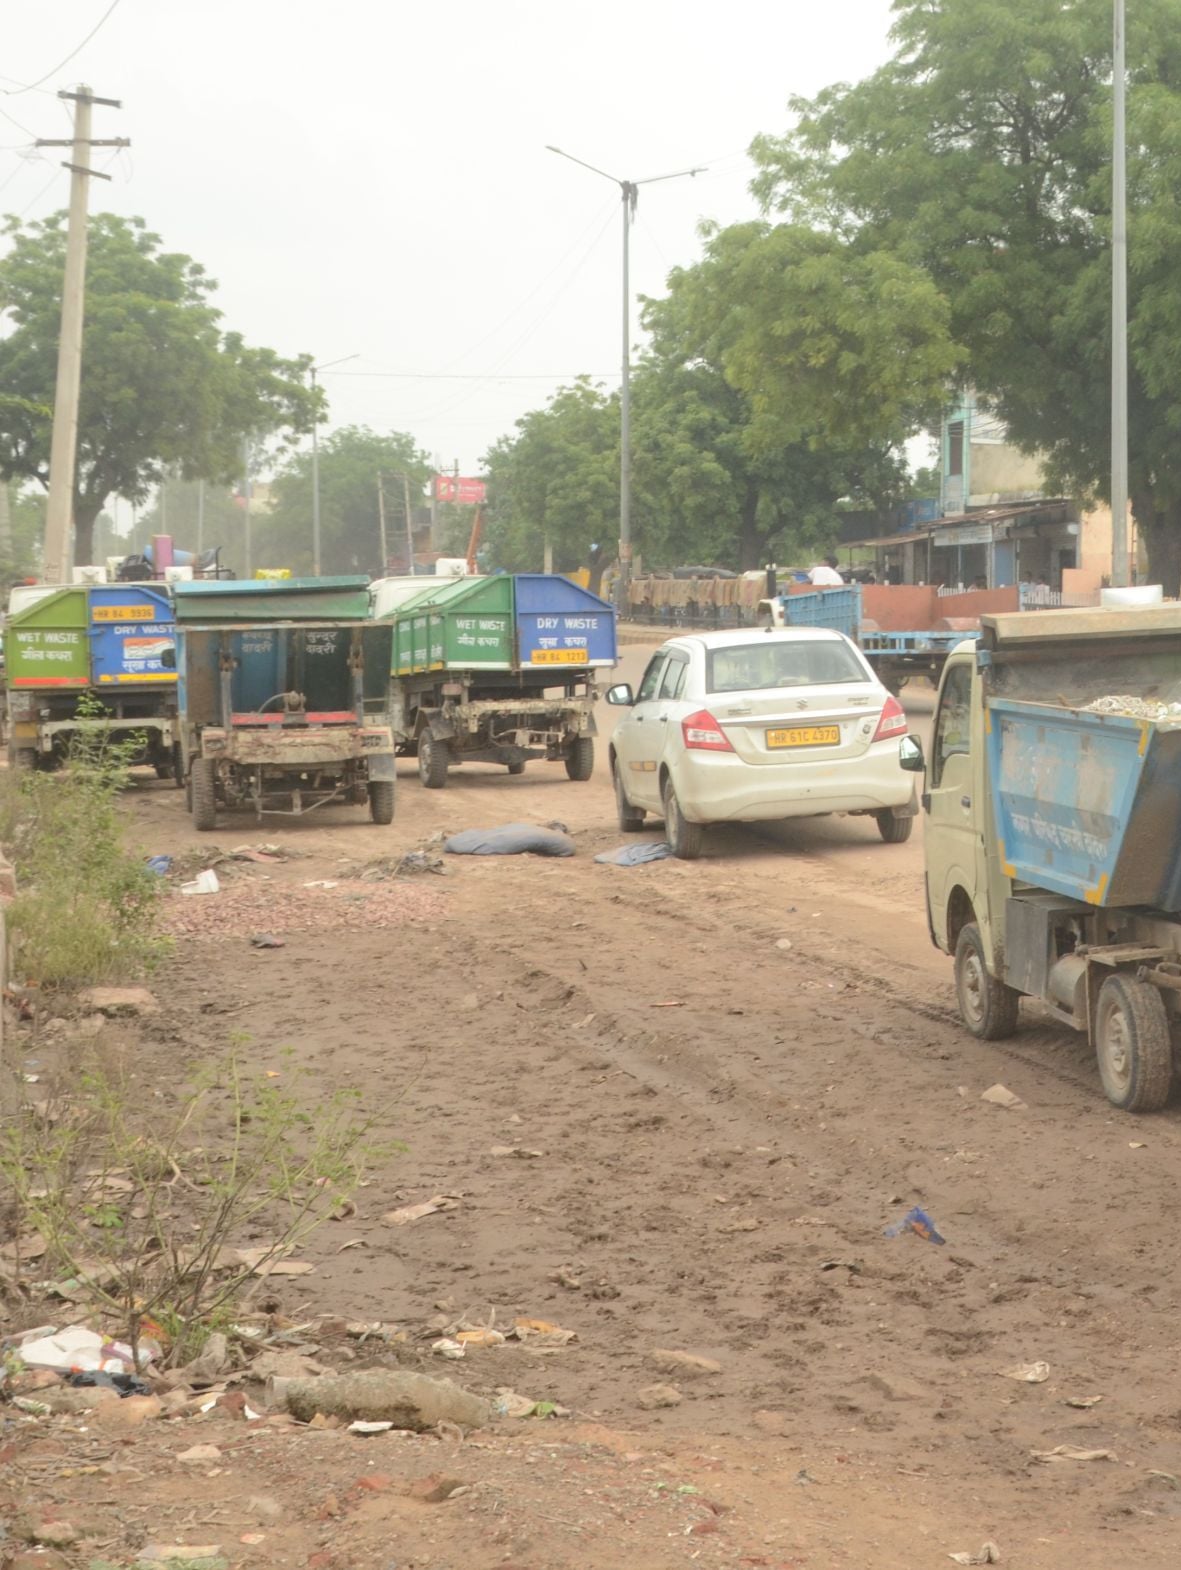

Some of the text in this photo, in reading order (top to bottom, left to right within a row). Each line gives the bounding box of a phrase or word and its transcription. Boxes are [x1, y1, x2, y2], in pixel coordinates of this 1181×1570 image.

[456, 619, 505, 631] WET WASTE
[537, 618, 598, 629] DRY WASTE
[114, 625, 173, 634] DRY WAST
[17, 633, 79, 644] WET WASTE
[775, 732, 787, 744] HR
[813, 729, 838, 741] 4370
